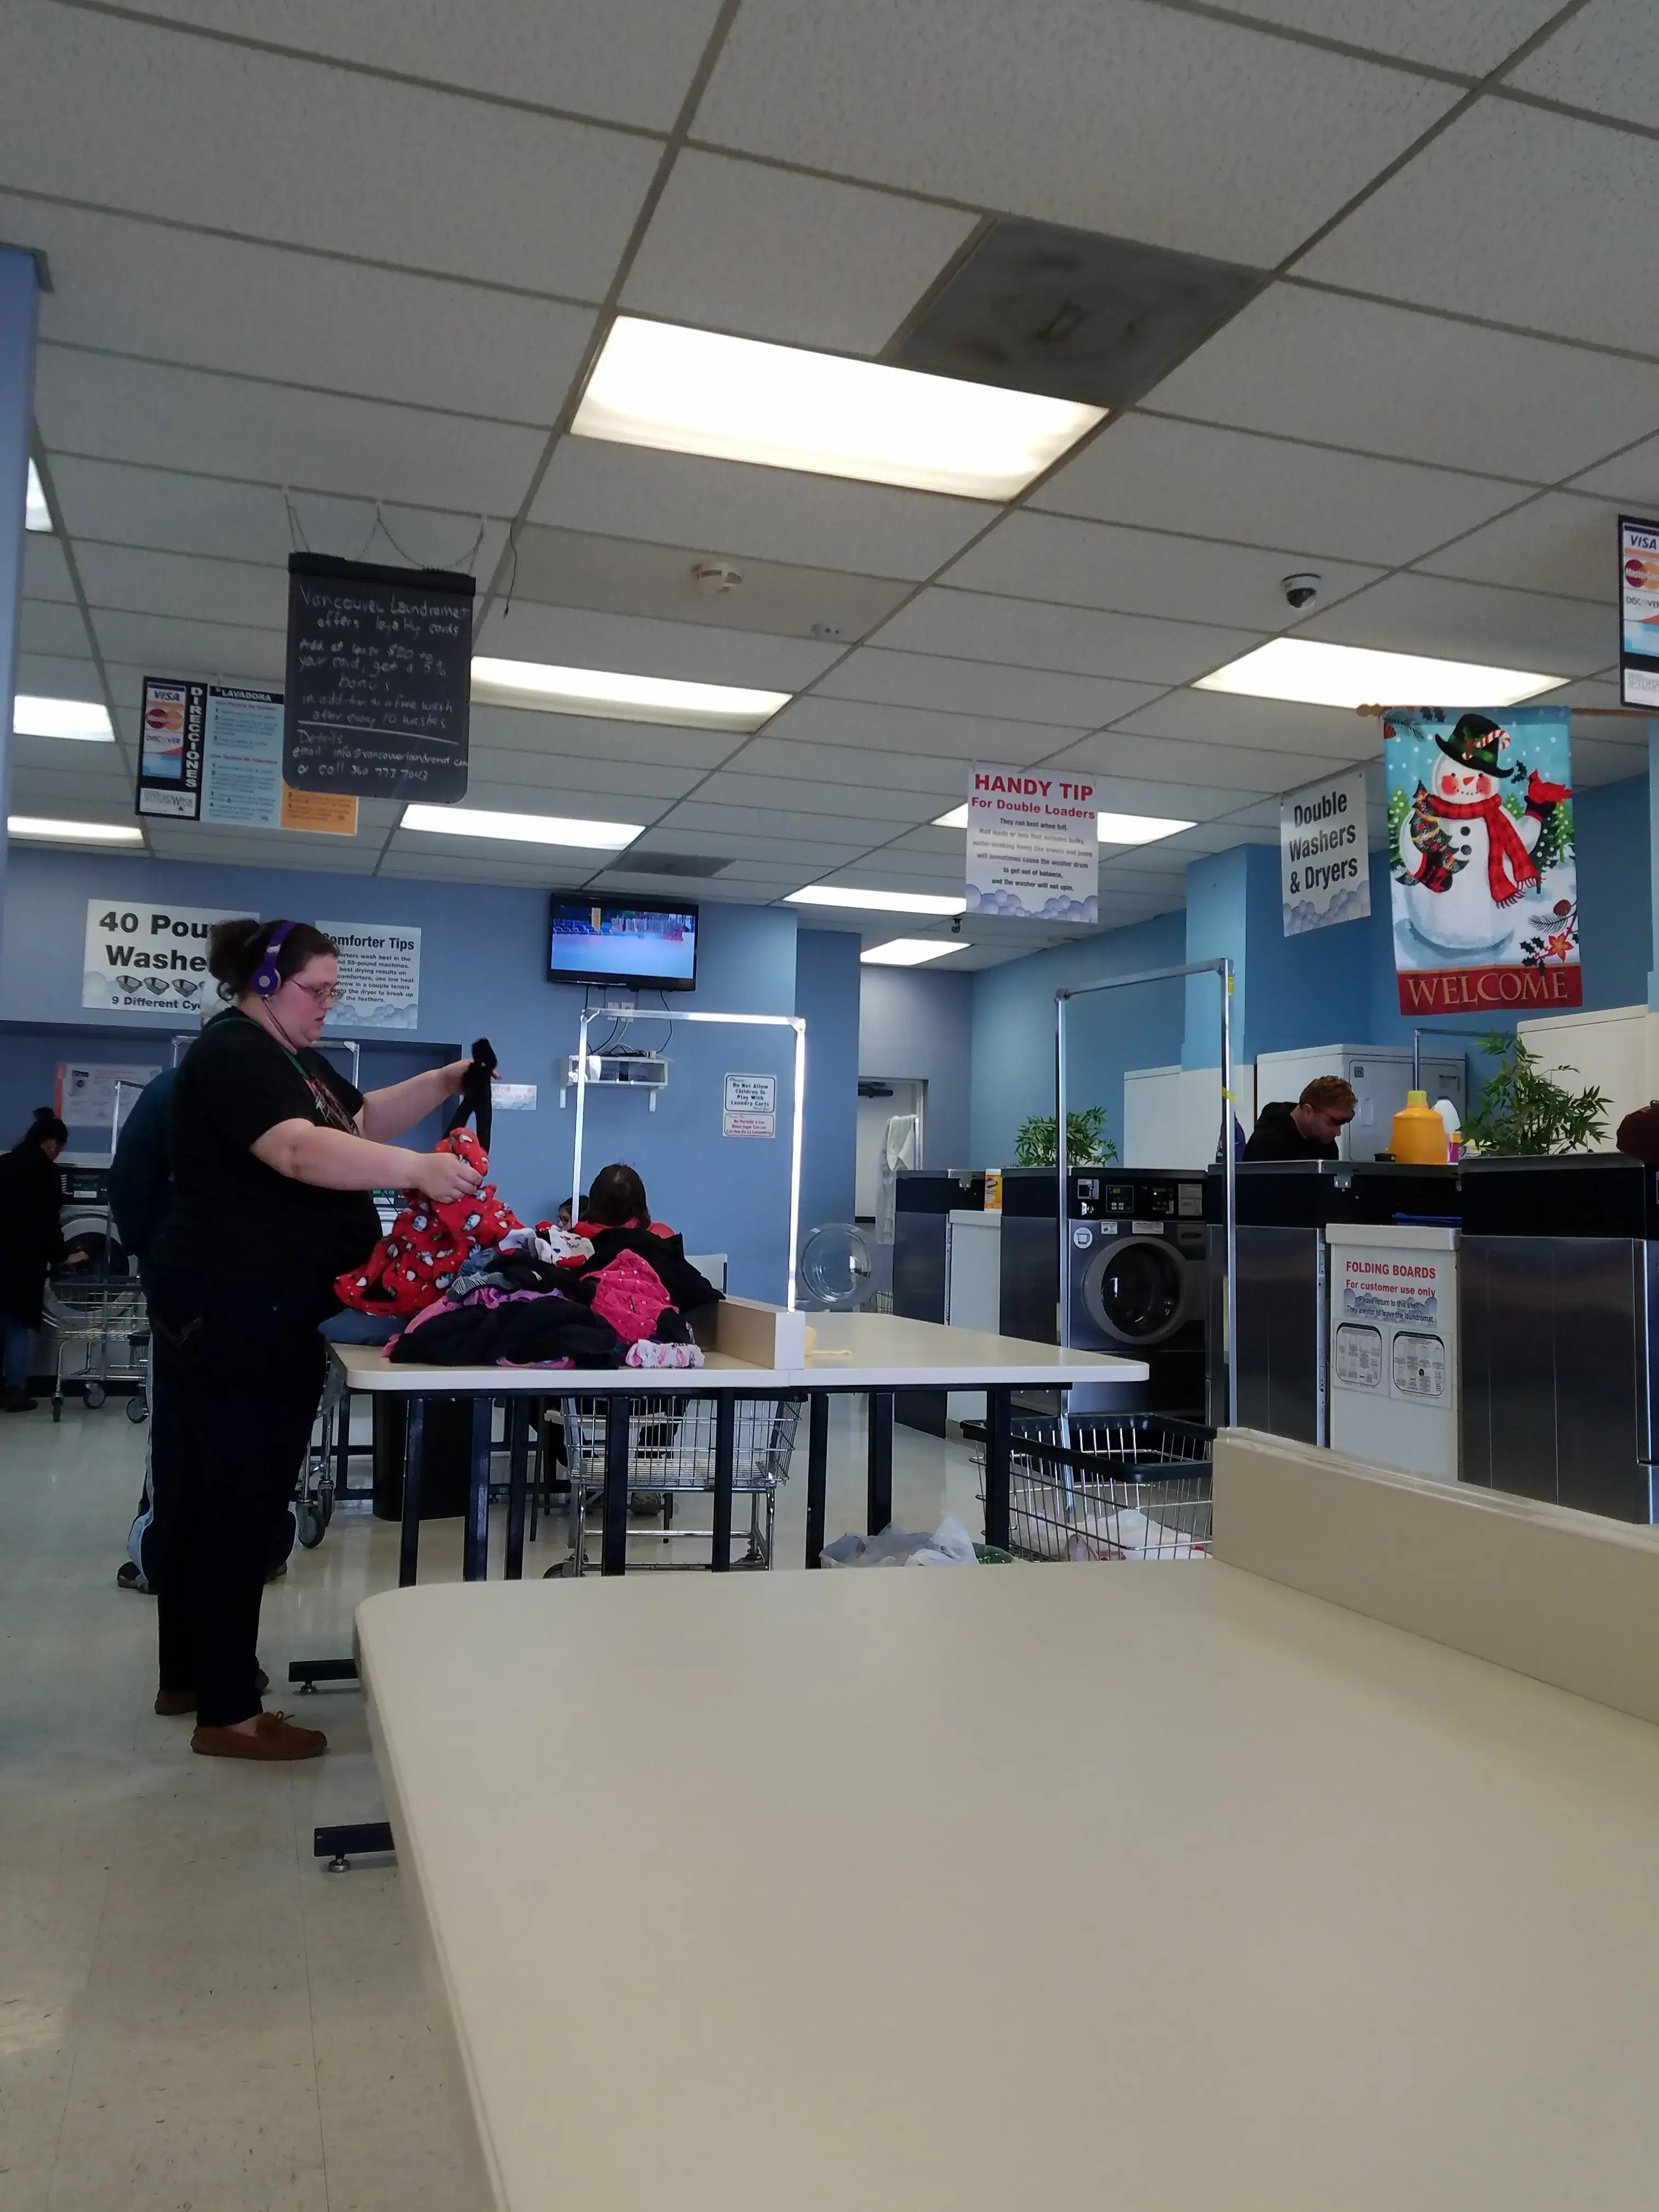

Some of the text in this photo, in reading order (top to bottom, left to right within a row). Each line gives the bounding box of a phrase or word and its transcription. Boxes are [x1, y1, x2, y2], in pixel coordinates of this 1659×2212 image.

[1630, 535, 1657, 549] VISA
[300, 585, 385, 613] Vancouver
[154, 690, 180, 702] VISA
[221, 689, 272, 702] LAVADORA
[185, 686, 203, 788] DIRECCIONES
[975, 774, 1093, 802] HANDY TIP
[972, 797, 1096, 820] For Double Loaders
[1294, 791, 1347, 828] Double
[1000, 817, 1013, 826] They
[1289, 824, 1356, 862] Washers
[1040, 871, 1063, 879] balance,
[1290, 857, 1358, 895] & Dryers
[99, 911, 211, 939] 40 Pou
[389, 937, 415, 951] Tips
[105, 944, 207, 972] Washe
[1407, 972, 1568, 1007] WELCOME
[111, 996, 119, 1005] 9
[123, 996, 179, 1008] Different
[1346, 1261, 1436, 1279] FOLDING BOARDS
[1346, 1279, 1436, 1297] For customer use only
[1347, 1305, 1357, 1314] They
